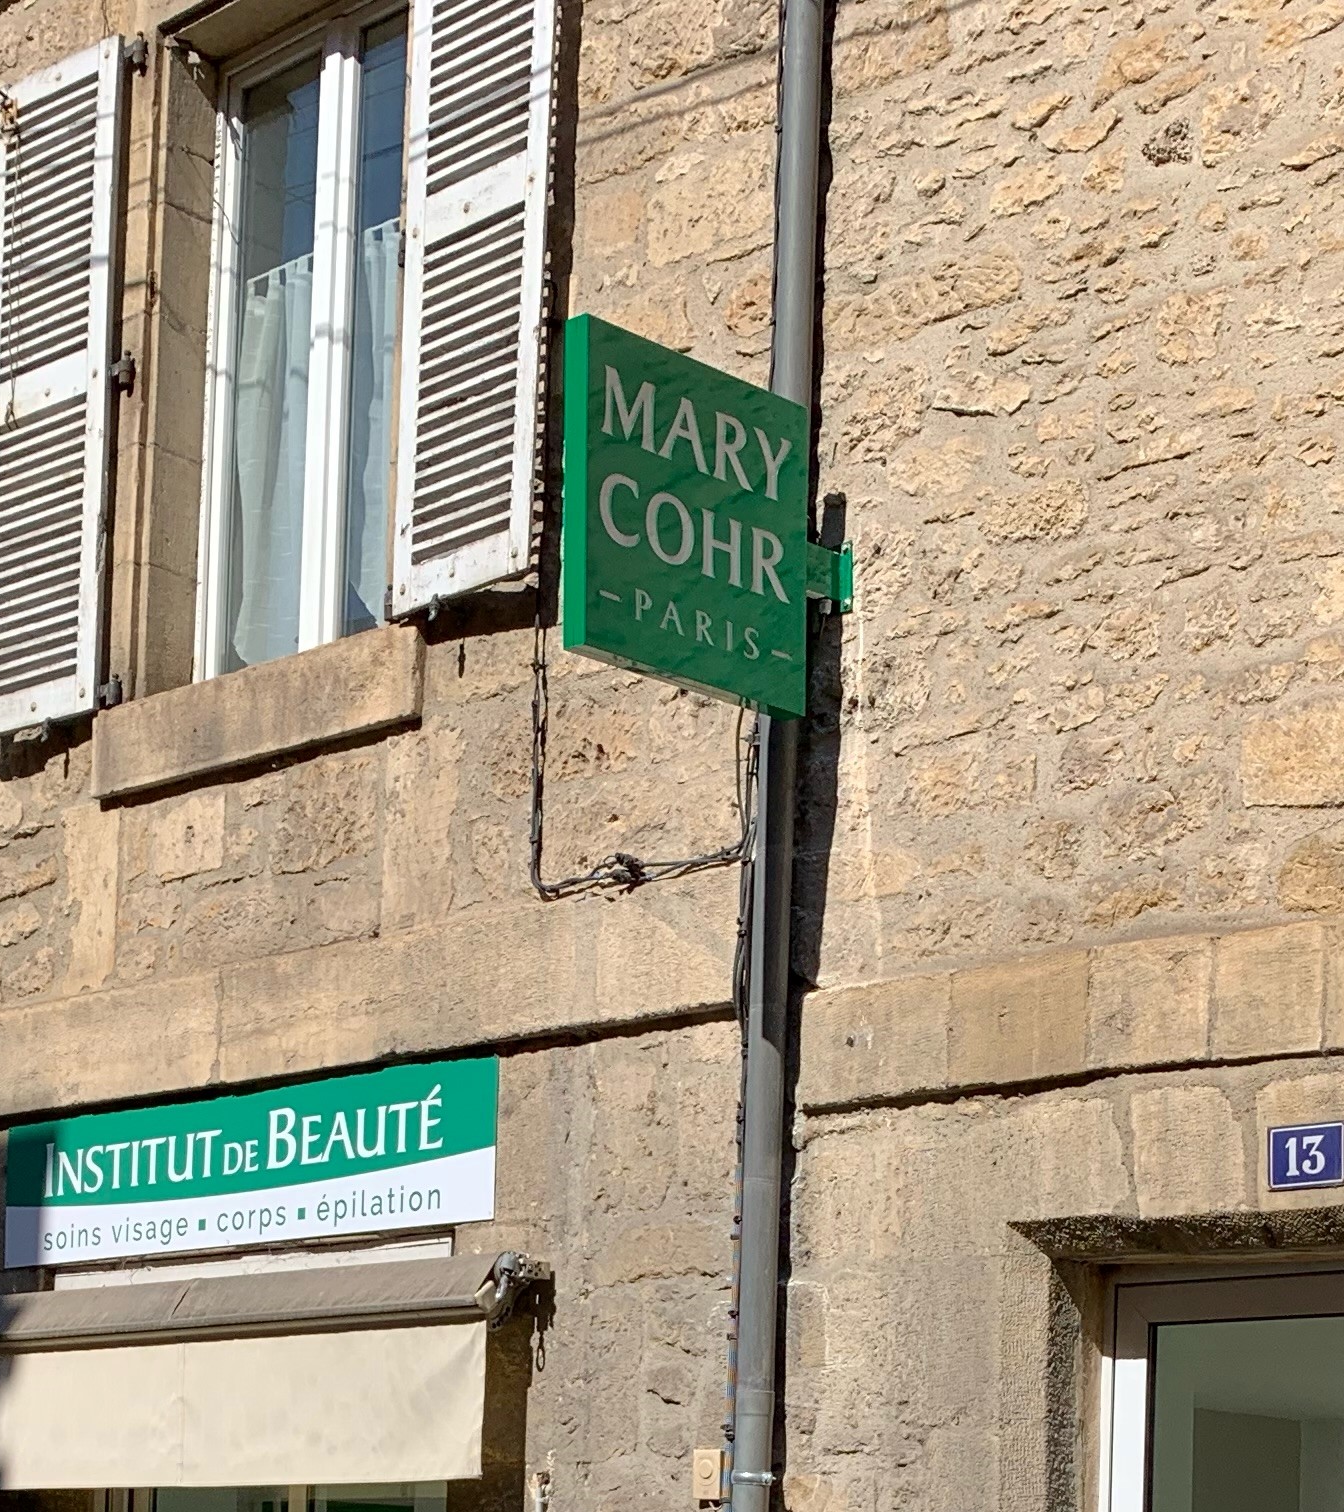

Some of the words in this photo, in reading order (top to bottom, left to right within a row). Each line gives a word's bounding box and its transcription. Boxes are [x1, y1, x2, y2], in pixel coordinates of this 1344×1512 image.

[601, 365, 792, 501] MARY
[599, 473, 790, 604] COHR
[634, 588, 761, 660] PARIS
[44, 1129, 223, 1198] INSTITUT
[223, 1139, 260, 1176] DE
[266, 1083, 445, 1170] BEAUTÉ
[1284, 1134, 1326, 1177] 13
[43, 1224, 102, 1251] soins
[112, 1214, 189, 1246] visage
[216, 1204, 287, 1235] corps
[316, 1185, 443, 1226] épilation
